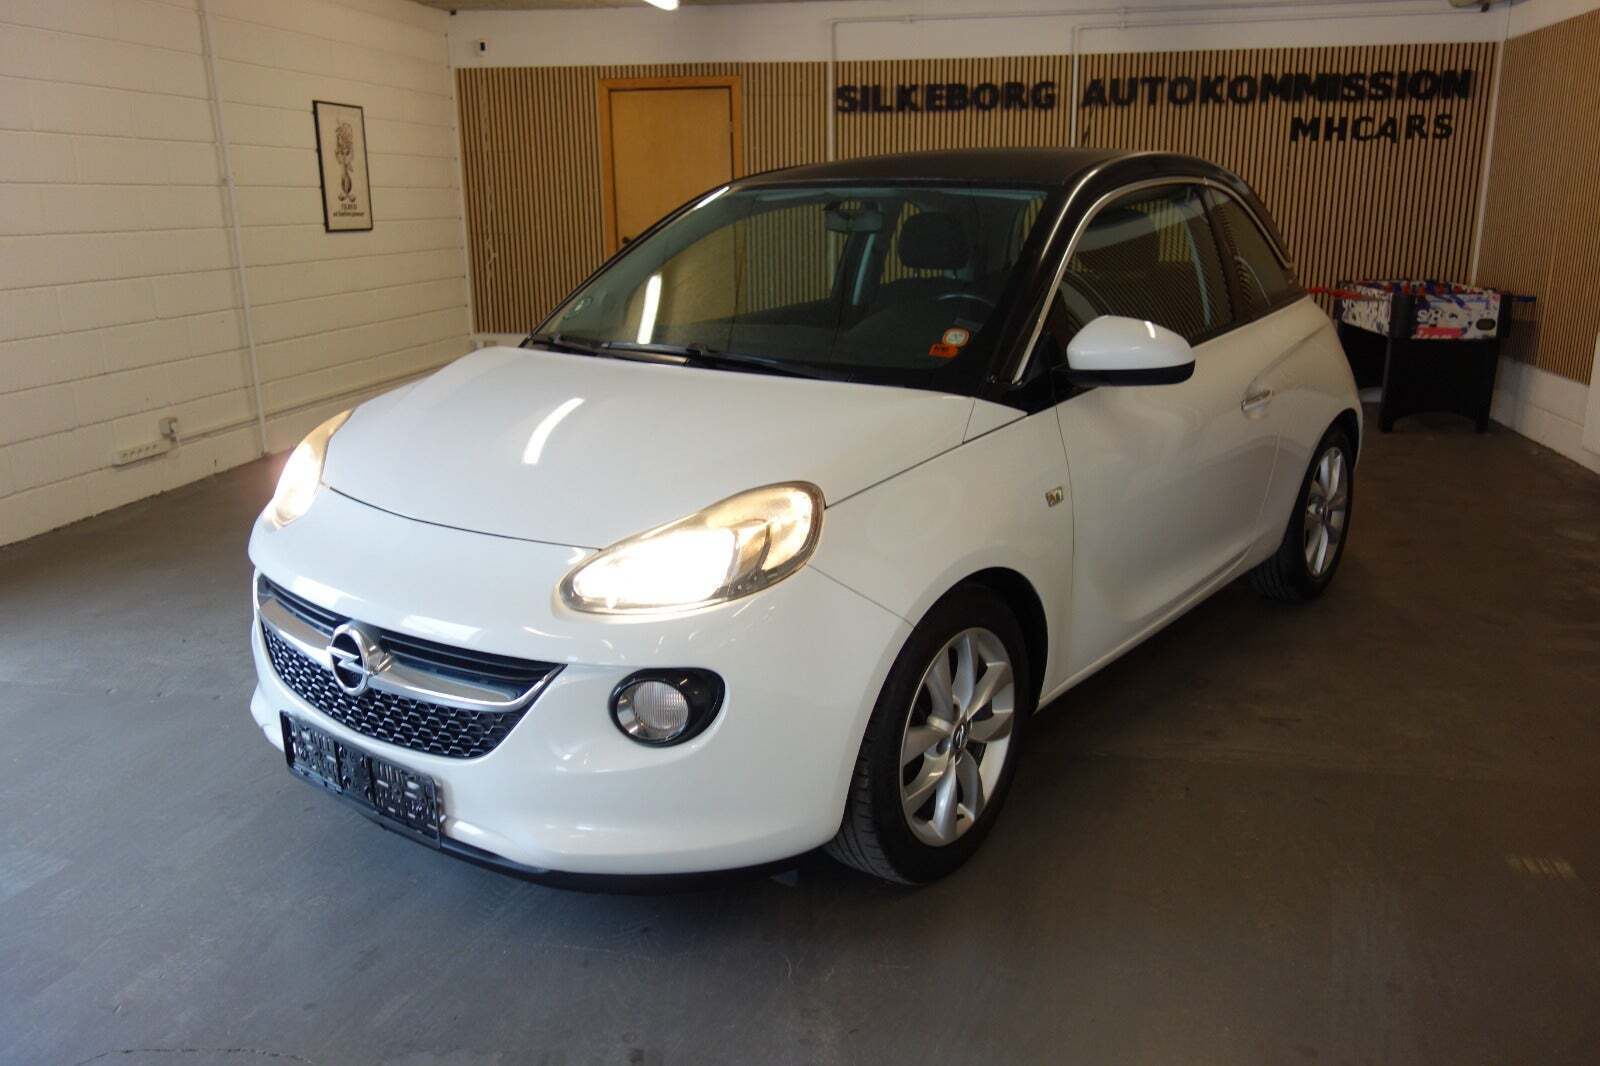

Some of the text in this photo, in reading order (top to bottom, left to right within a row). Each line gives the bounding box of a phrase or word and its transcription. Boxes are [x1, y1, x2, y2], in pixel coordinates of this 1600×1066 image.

[835, 68, 1473, 113] SILKEBORG AUTOKOMMISSION
[1290, 113, 1454, 143] MHCARS
